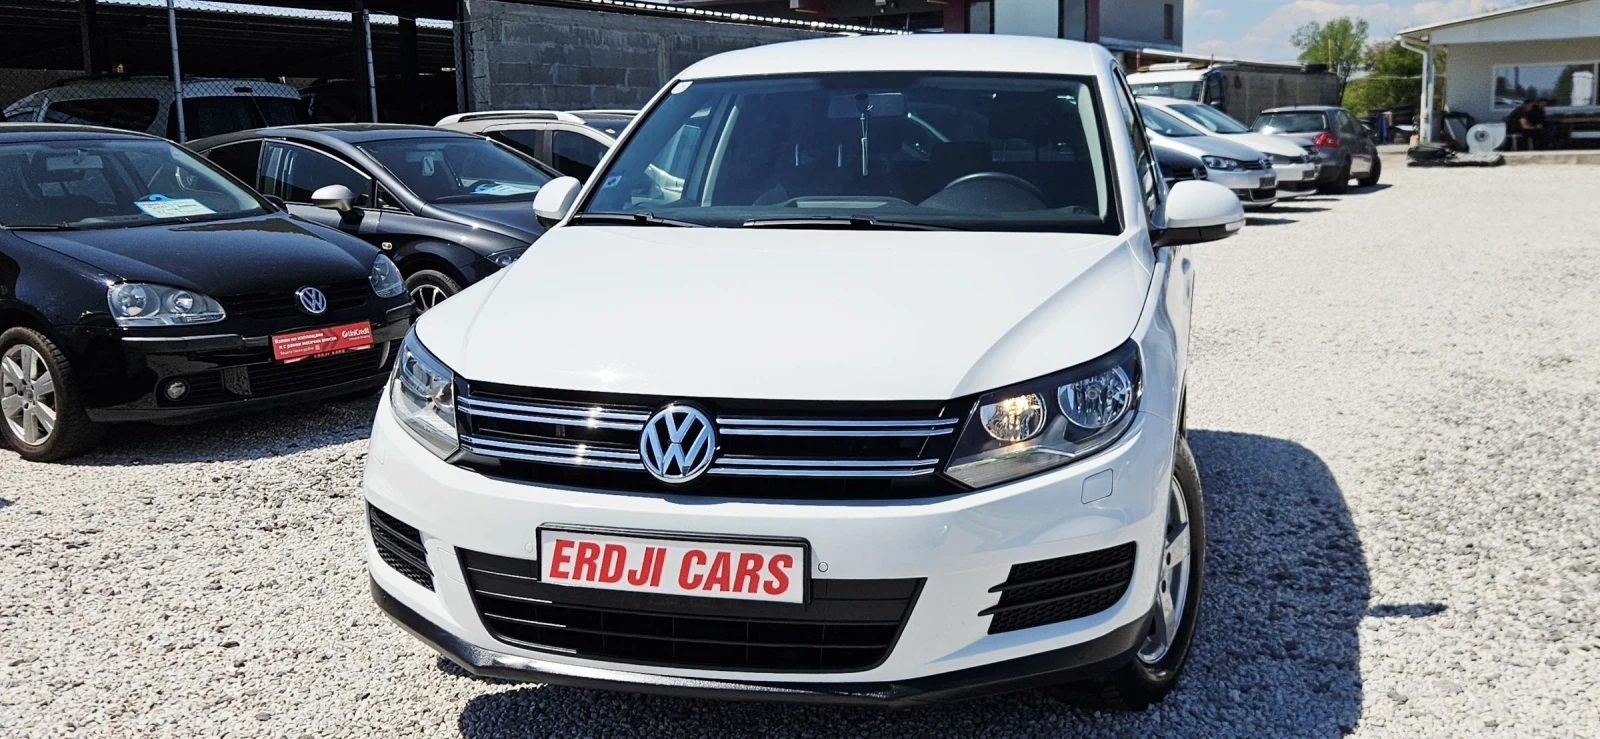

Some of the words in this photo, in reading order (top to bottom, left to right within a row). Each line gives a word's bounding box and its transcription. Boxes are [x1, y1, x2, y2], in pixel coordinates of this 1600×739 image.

[641, 405, 715, 483] VW
[549, 539, 667, 587] ERDJI
[678, 549, 793, 594] CARS
